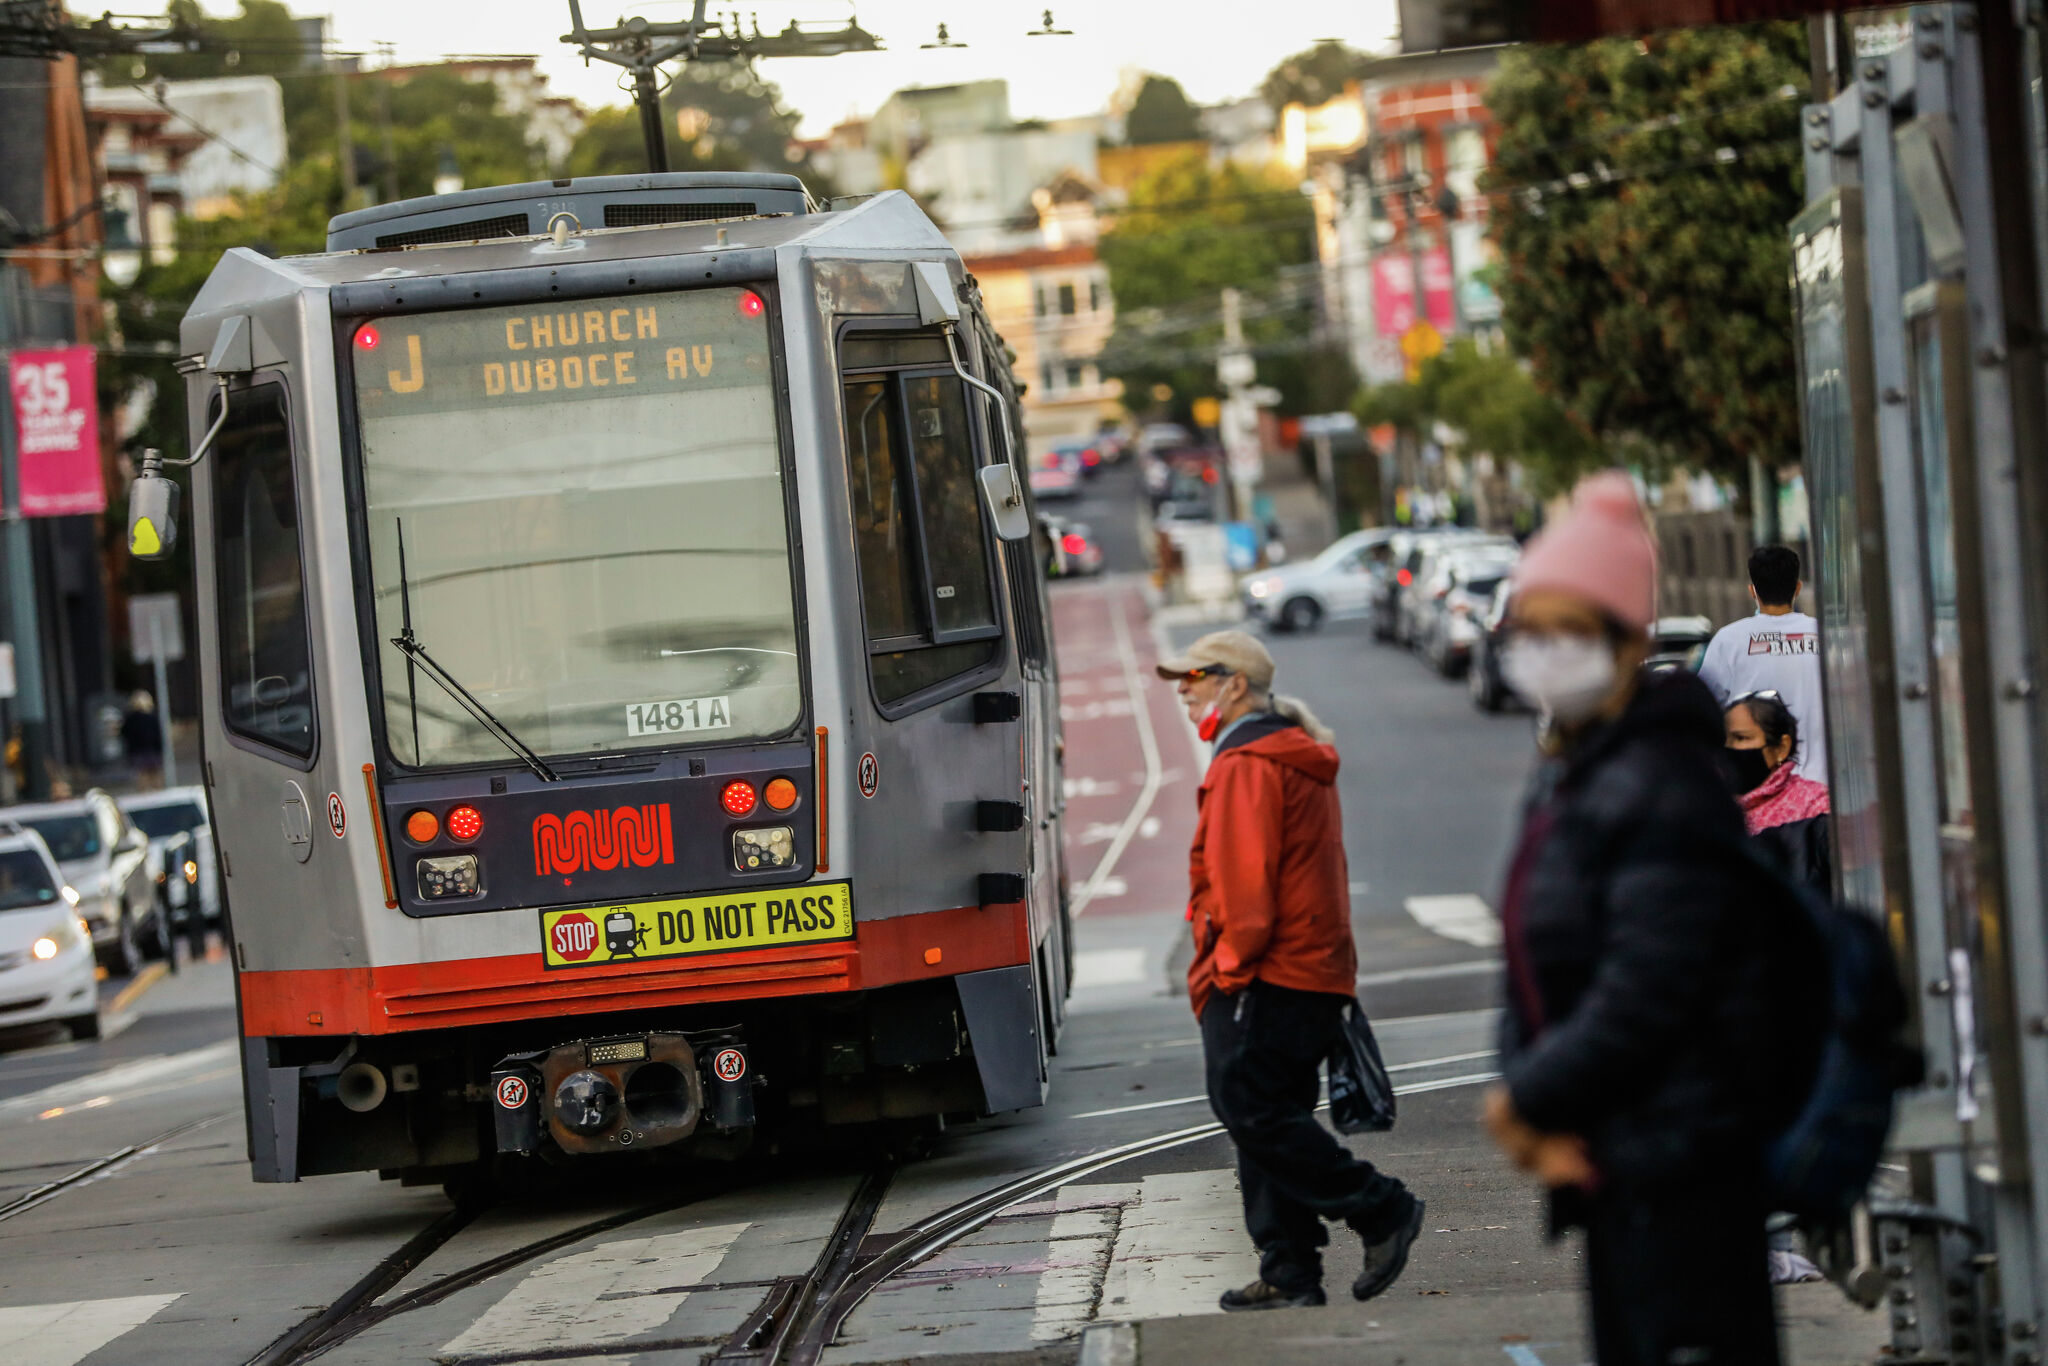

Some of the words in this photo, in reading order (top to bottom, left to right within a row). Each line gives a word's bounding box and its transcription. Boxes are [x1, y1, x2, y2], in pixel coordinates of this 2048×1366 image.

[505, 306, 659, 351] CHURCH
[16, 361, 71, 417] 35
[387, 334, 425, 393] J
[483, 351, 637, 397] DUBOCE
[665, 344, 714, 380] AV
[630, 700, 701, 733] 1481
[708, 698, 728, 727] A
[532, 803, 675, 877] MUNI
[555, 921, 596, 953] STOP
[657, 909, 695, 946] DO
[703, 902, 757, 942] NOT
[766, 895, 836, 935] PASS
